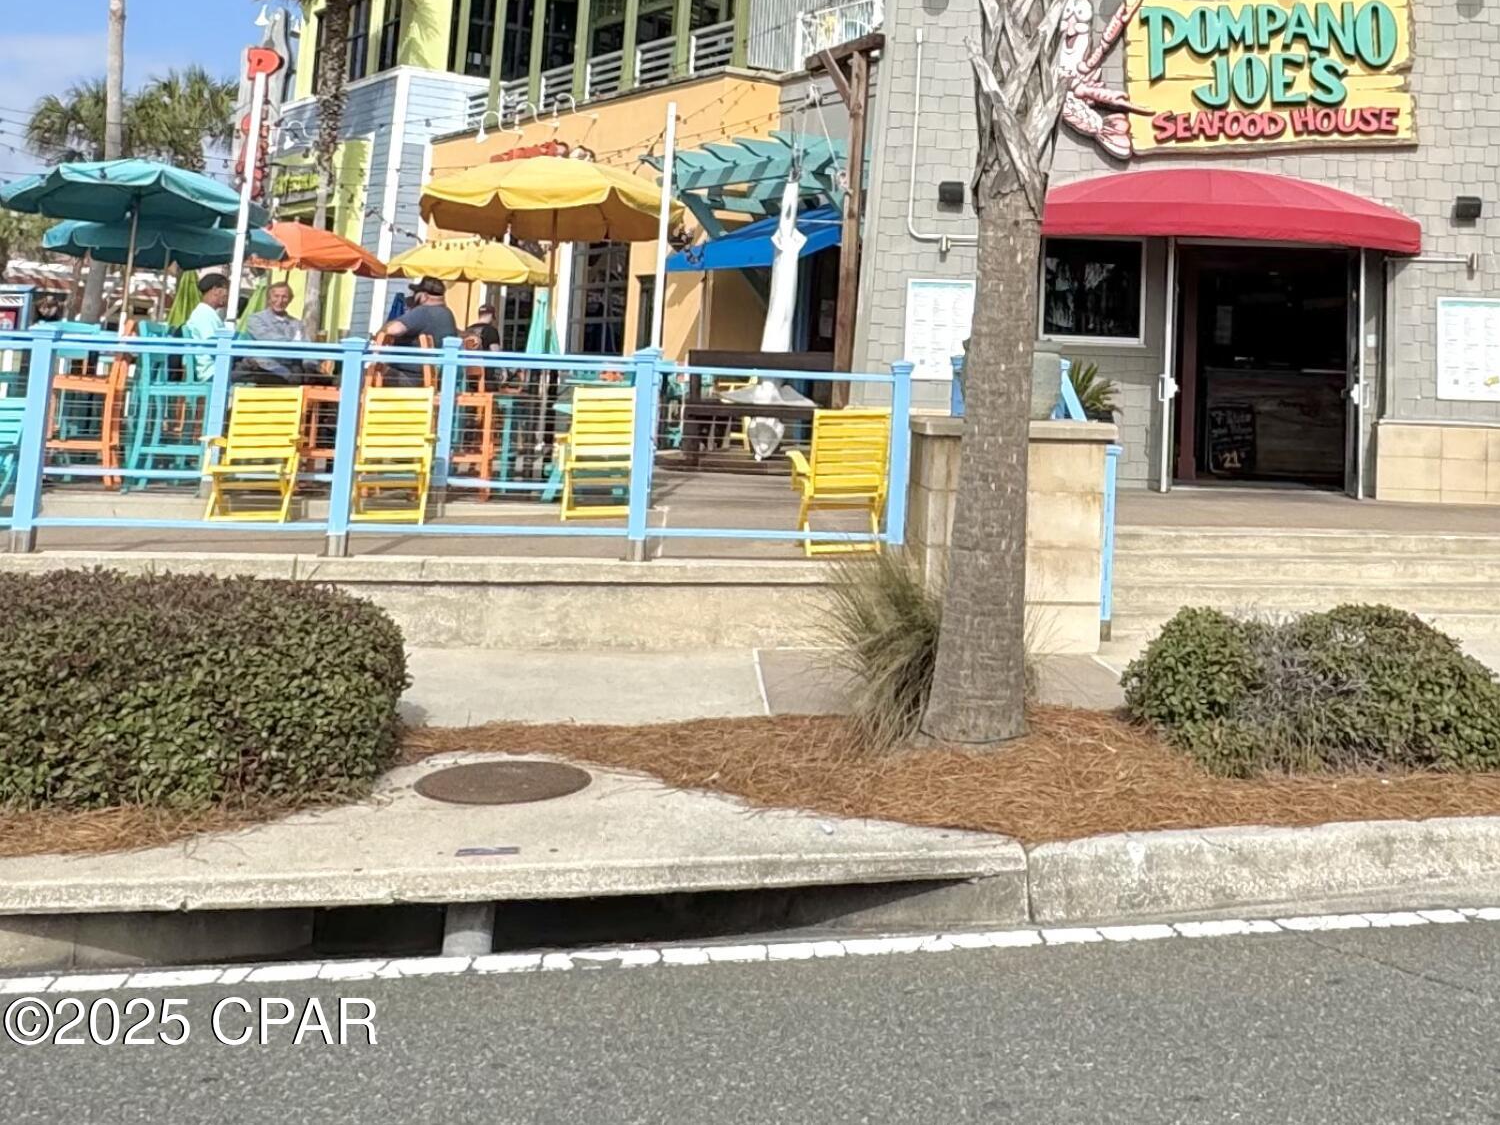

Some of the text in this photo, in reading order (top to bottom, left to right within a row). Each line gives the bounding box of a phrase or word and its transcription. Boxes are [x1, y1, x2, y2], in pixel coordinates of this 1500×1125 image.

[1140, 0, 1398, 81] POMPANO
[1191, 52, 1349, 107] JOE'S
[1152, 107, 1400, 142] SEAFOOD HOUSE
